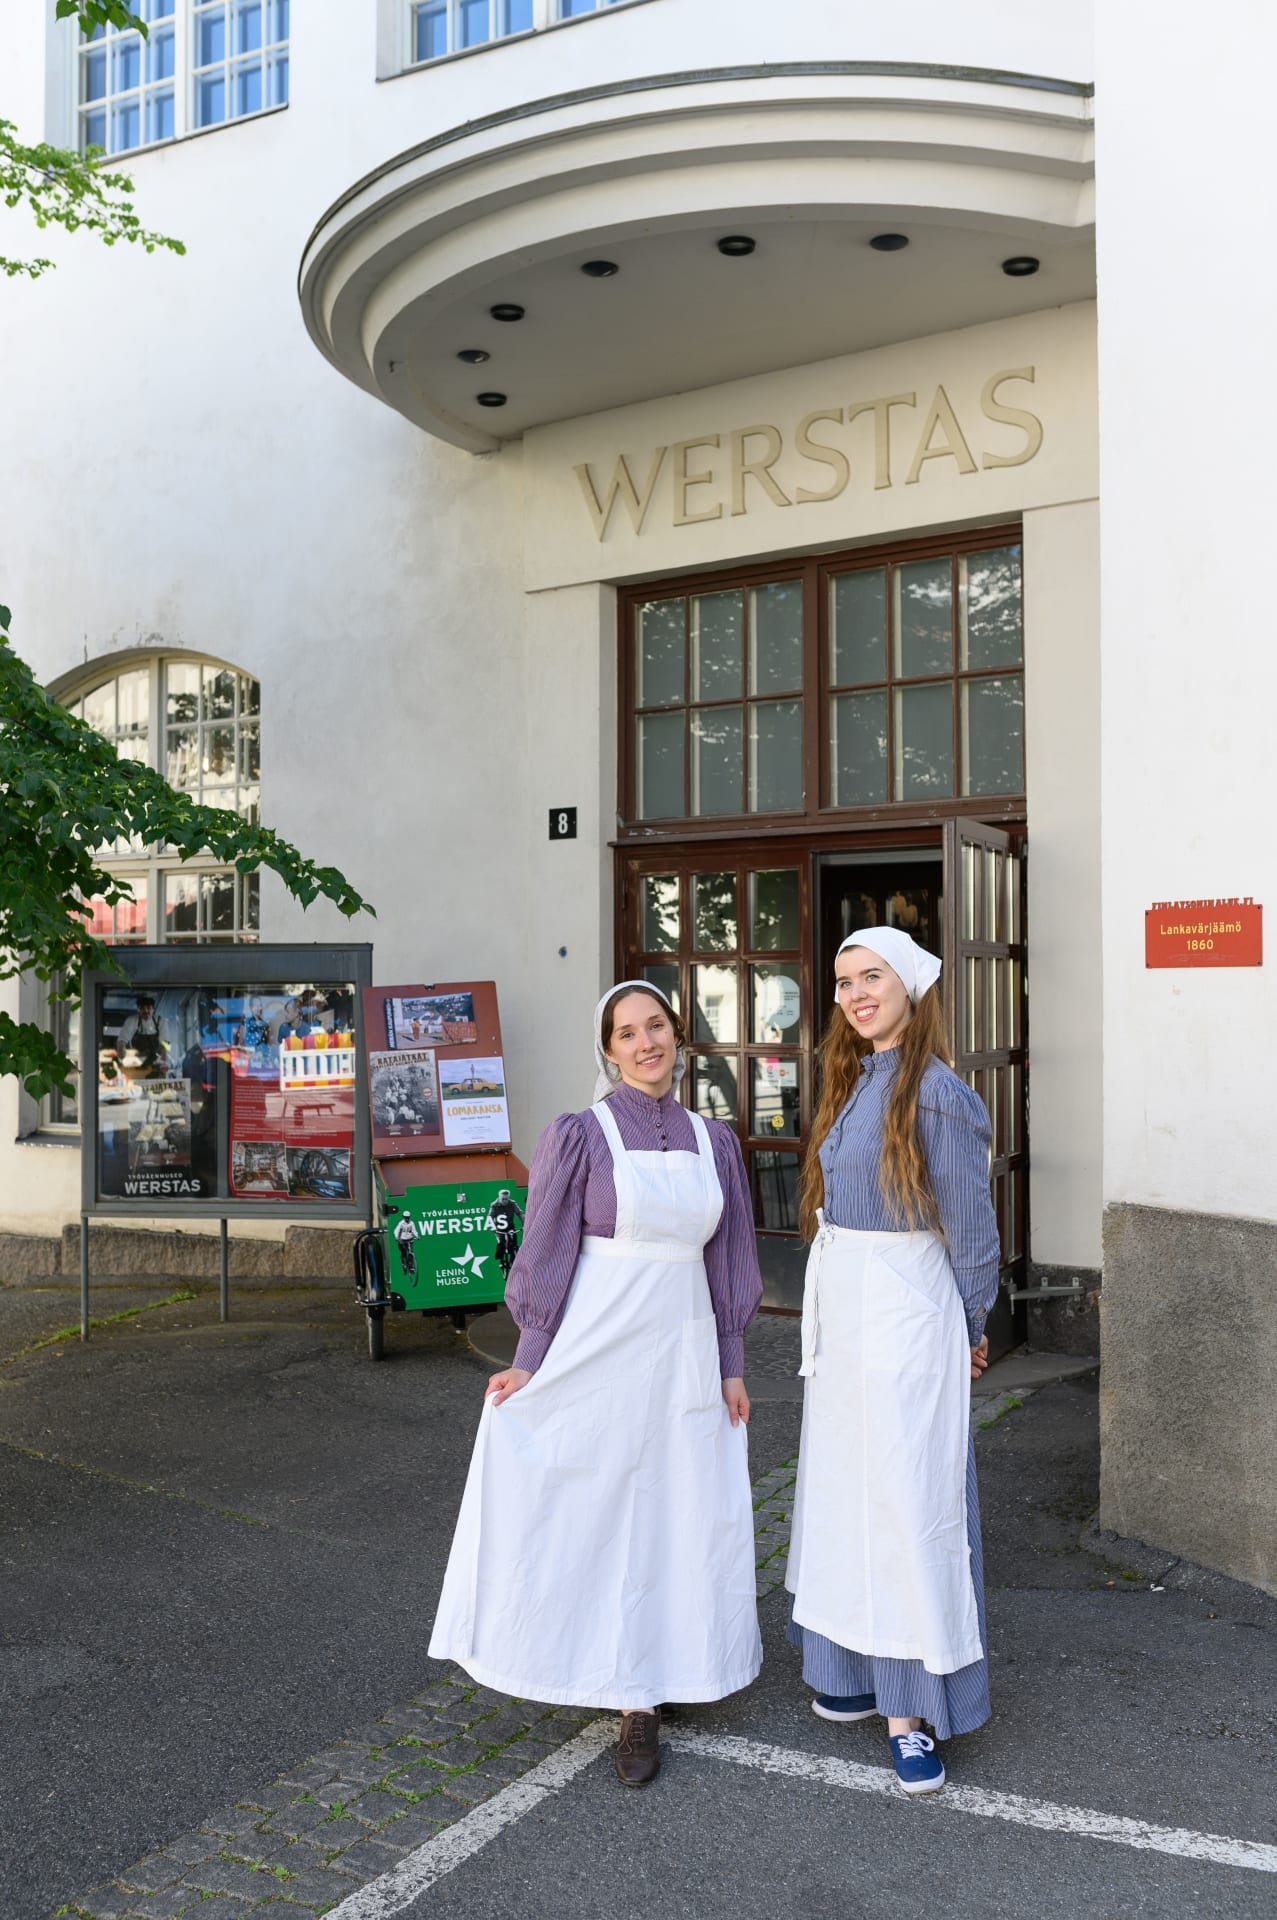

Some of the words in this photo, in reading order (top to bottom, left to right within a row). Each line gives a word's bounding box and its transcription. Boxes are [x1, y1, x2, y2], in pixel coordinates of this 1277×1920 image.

[572, 365, 1044, 543] WERSTAS
[558, 812, 569, 834] 8
[1160, 921, 1242, 936] Lankavärjäämö
[1186, 939, 1214, 951] 1860
[447, 1104, 503, 1117] LOMAKANSA
[124, 1179, 201, 1195] WERSTAS
[422, 1207, 486, 1218] TYÖVÄENMUSEO
[418, 1214, 509, 1236] WERSTAS
[436, 1268, 466, 1278] LENIN
[436, 1276, 470, 1287] MUSEO
